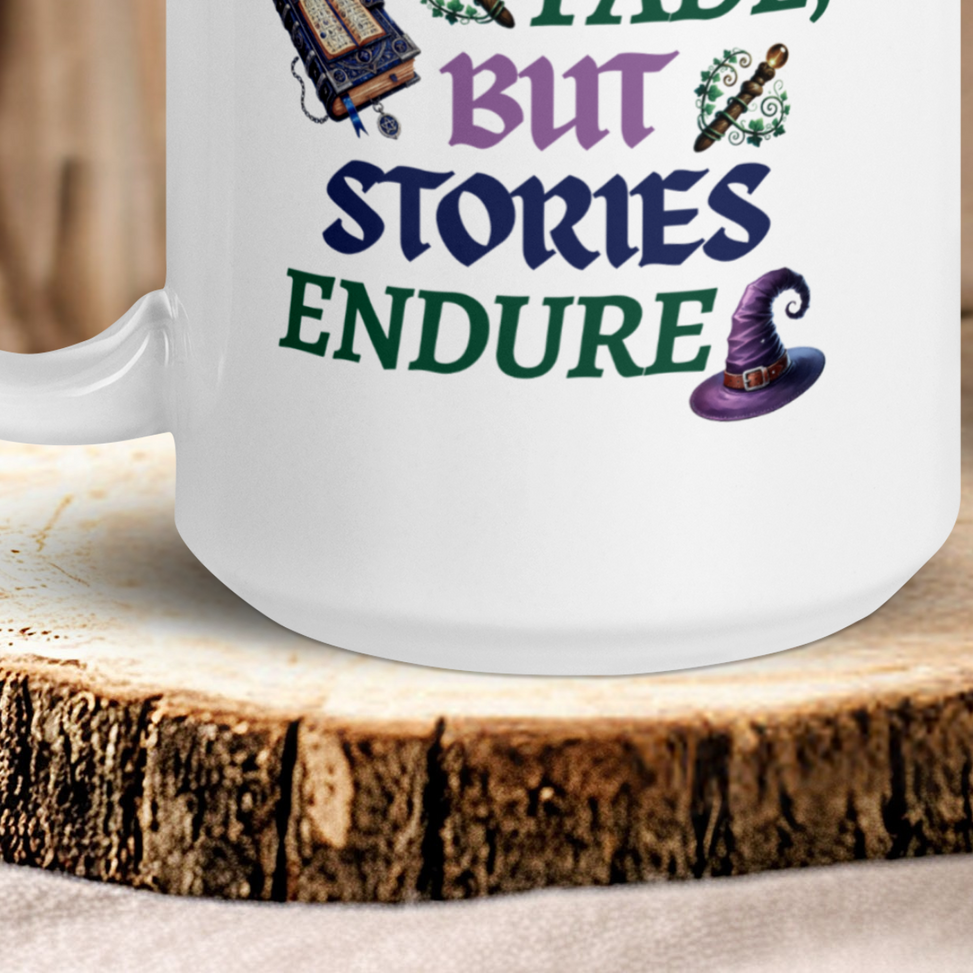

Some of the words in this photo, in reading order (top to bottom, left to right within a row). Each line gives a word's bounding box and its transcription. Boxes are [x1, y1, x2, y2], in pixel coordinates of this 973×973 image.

[438, 50, 680, 152] BUT
[321, 159, 772, 271] STORIES
[278, 266, 719, 380] ENDURE
